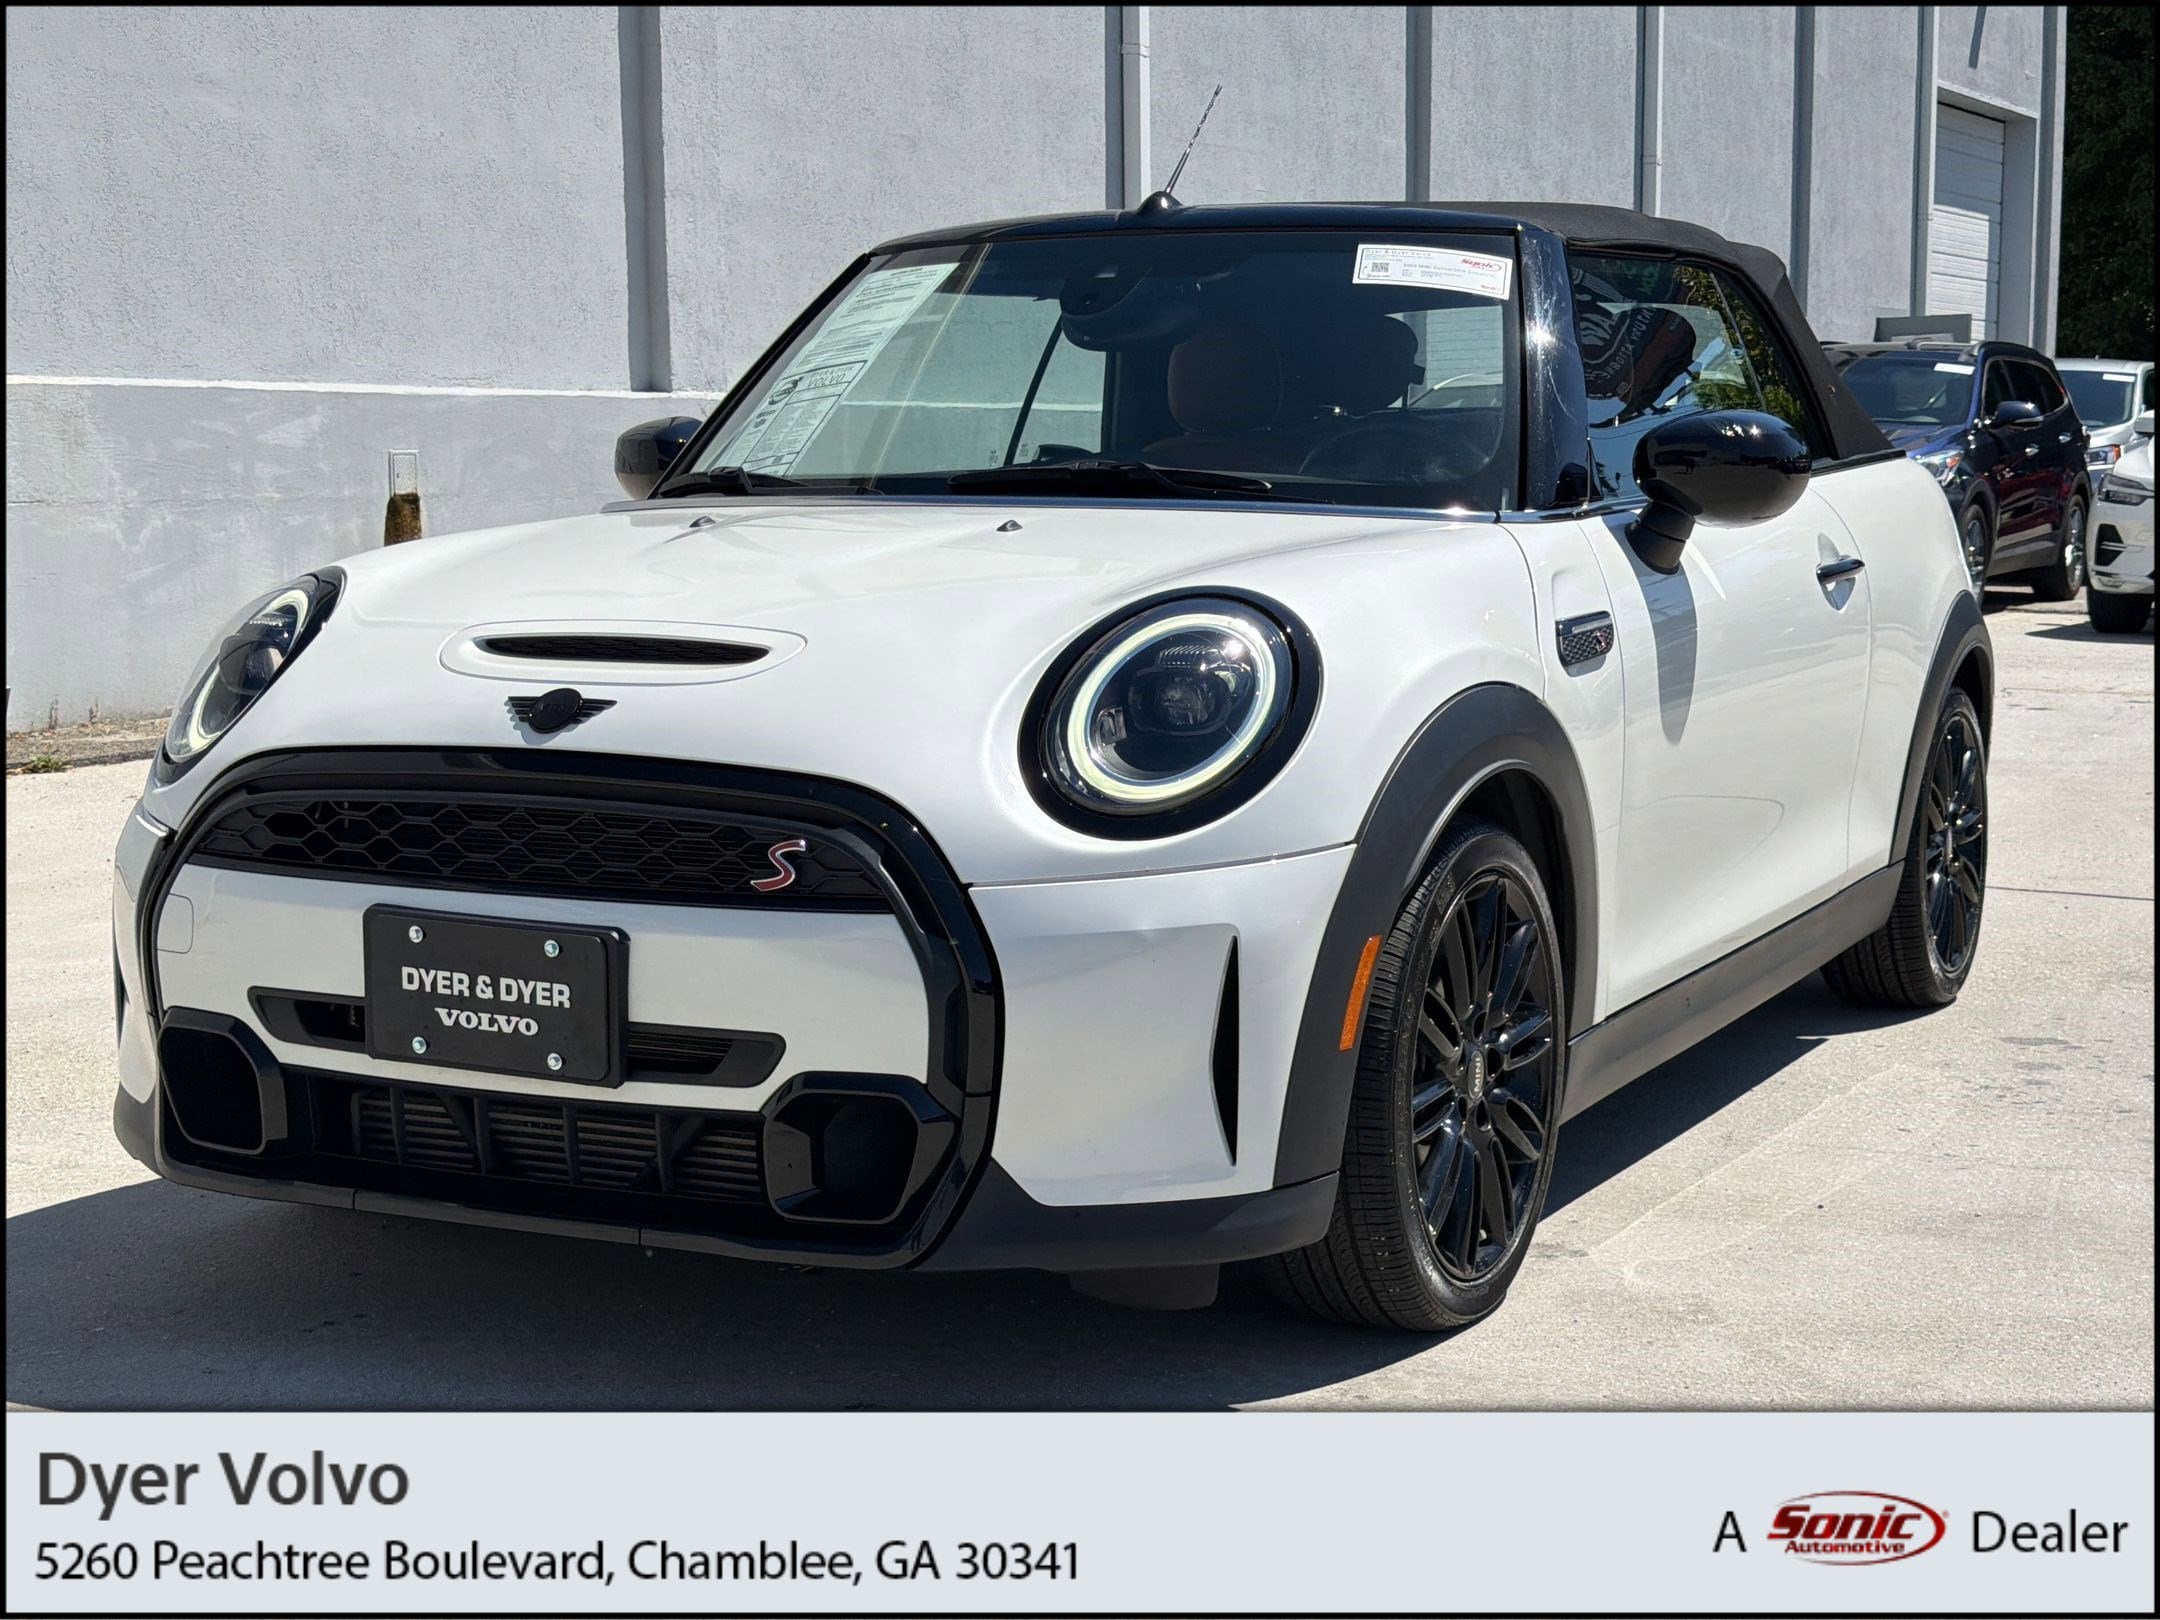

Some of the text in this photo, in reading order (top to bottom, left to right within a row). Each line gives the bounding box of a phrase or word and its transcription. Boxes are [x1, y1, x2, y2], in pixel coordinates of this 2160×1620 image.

[750, 839, 806, 892] S
[401, 966, 571, 1009] DYER & DYER
[434, 1007, 539, 1036] VOLVO
